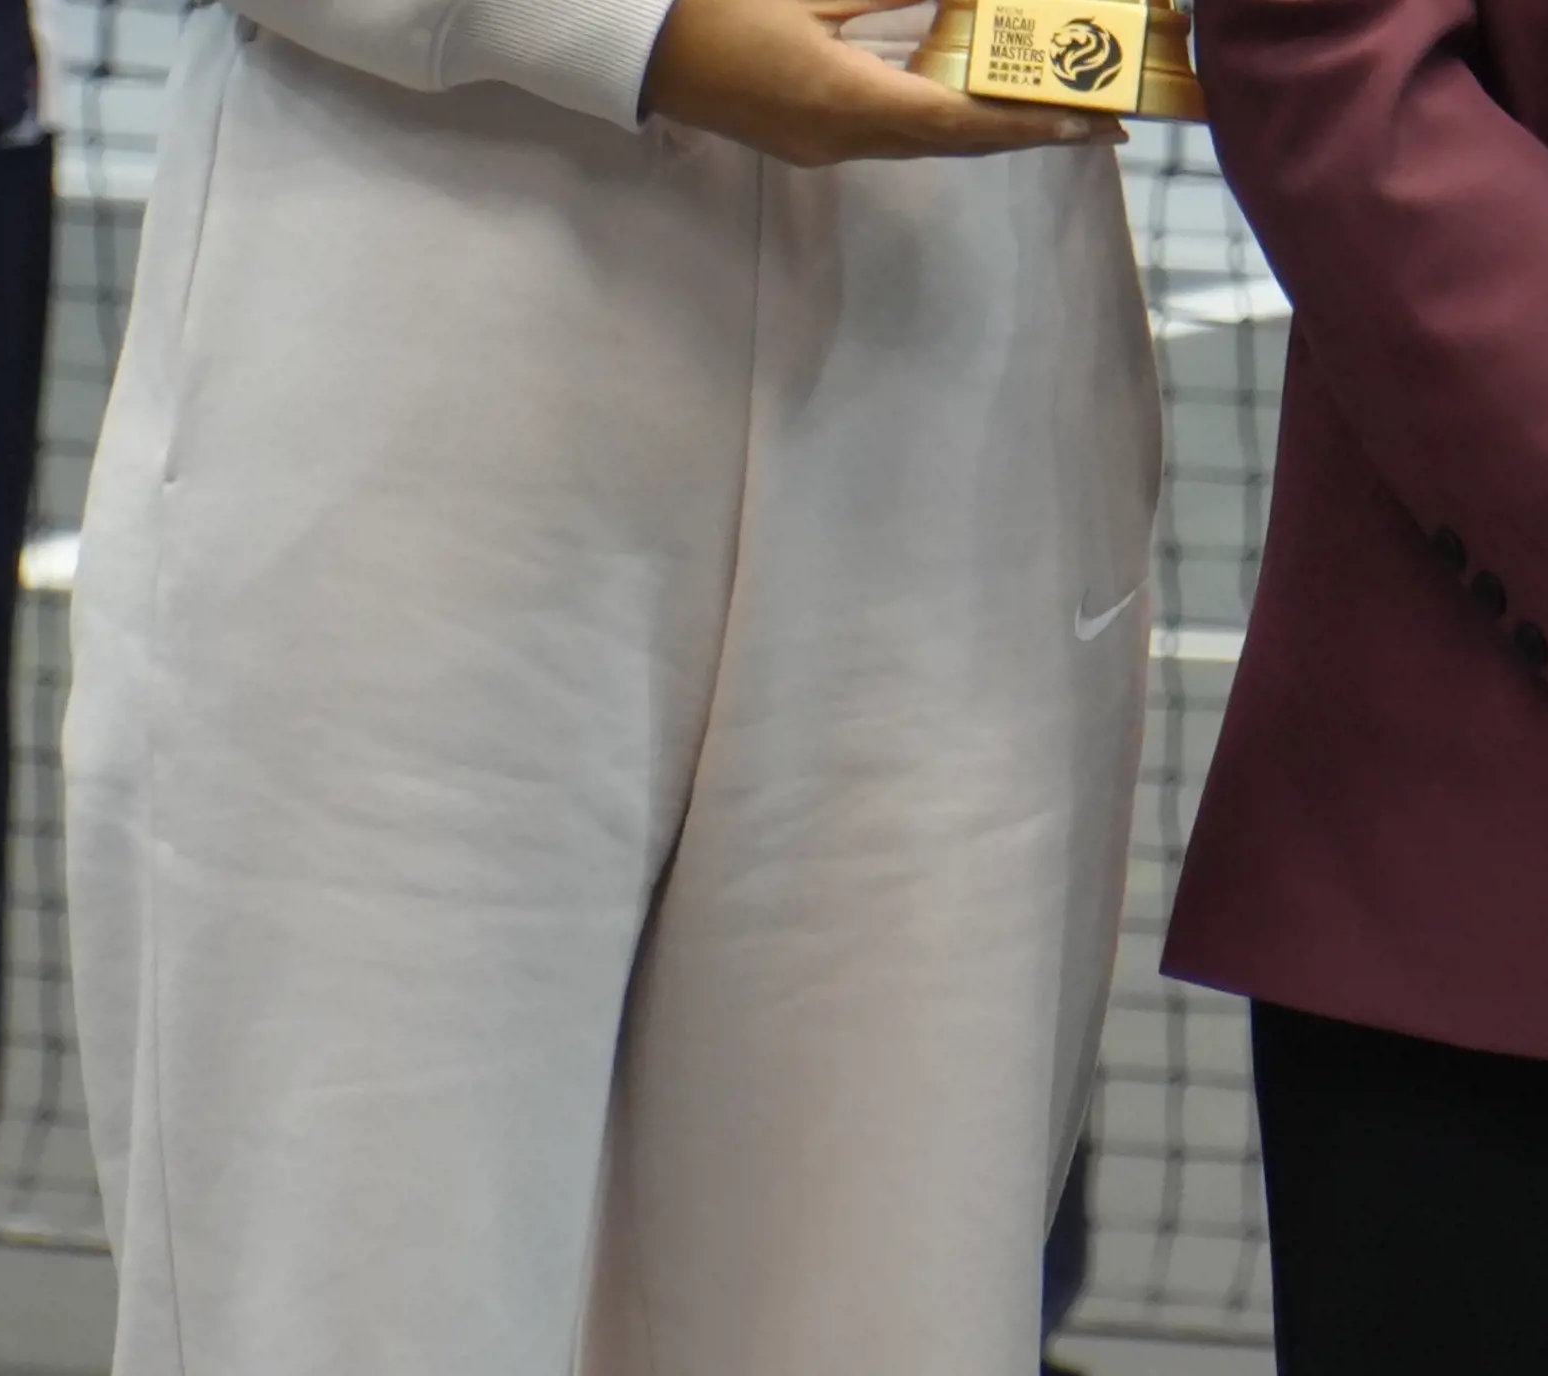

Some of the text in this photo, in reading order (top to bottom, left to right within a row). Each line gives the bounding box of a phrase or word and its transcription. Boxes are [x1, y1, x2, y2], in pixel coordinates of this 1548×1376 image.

[993, 14, 1036, 31] MACAU
[993, 29, 1034, 48] TENNIS
[990, 44, 1046, 63] MASTERS
